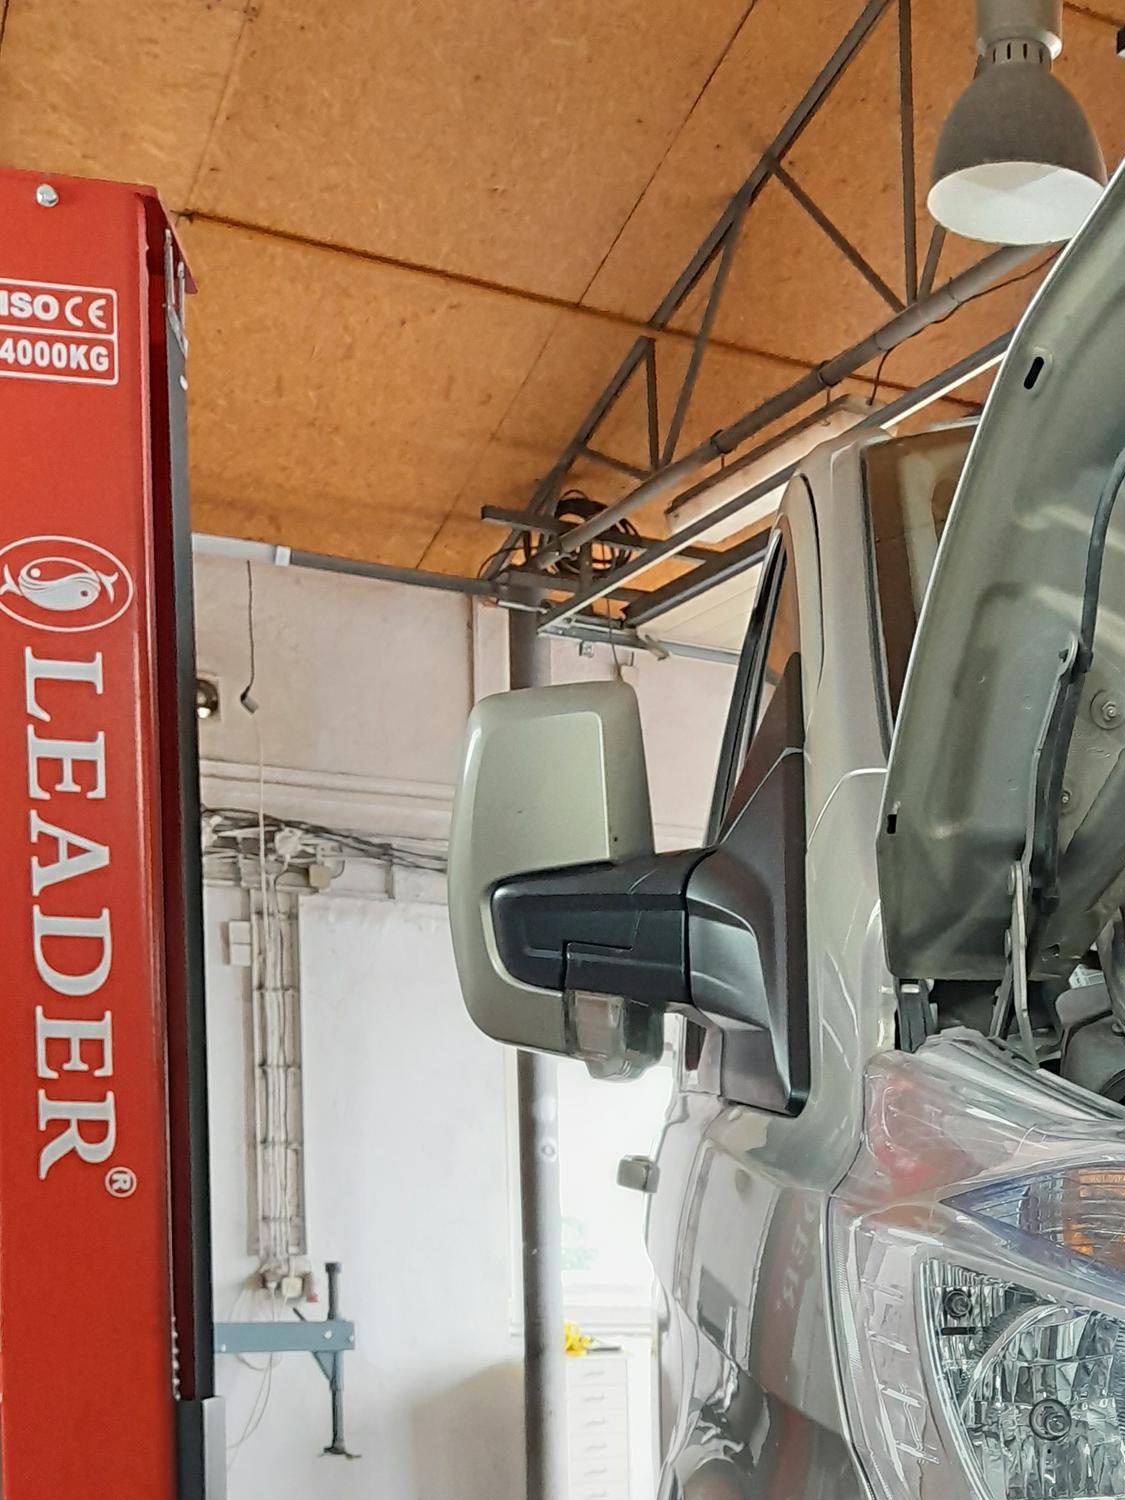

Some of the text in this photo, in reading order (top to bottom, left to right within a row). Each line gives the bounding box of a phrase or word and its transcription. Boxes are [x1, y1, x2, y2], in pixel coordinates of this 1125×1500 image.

[0, 289, 108, 330] ISO CE
[0, 337, 110, 373] 4000KG
